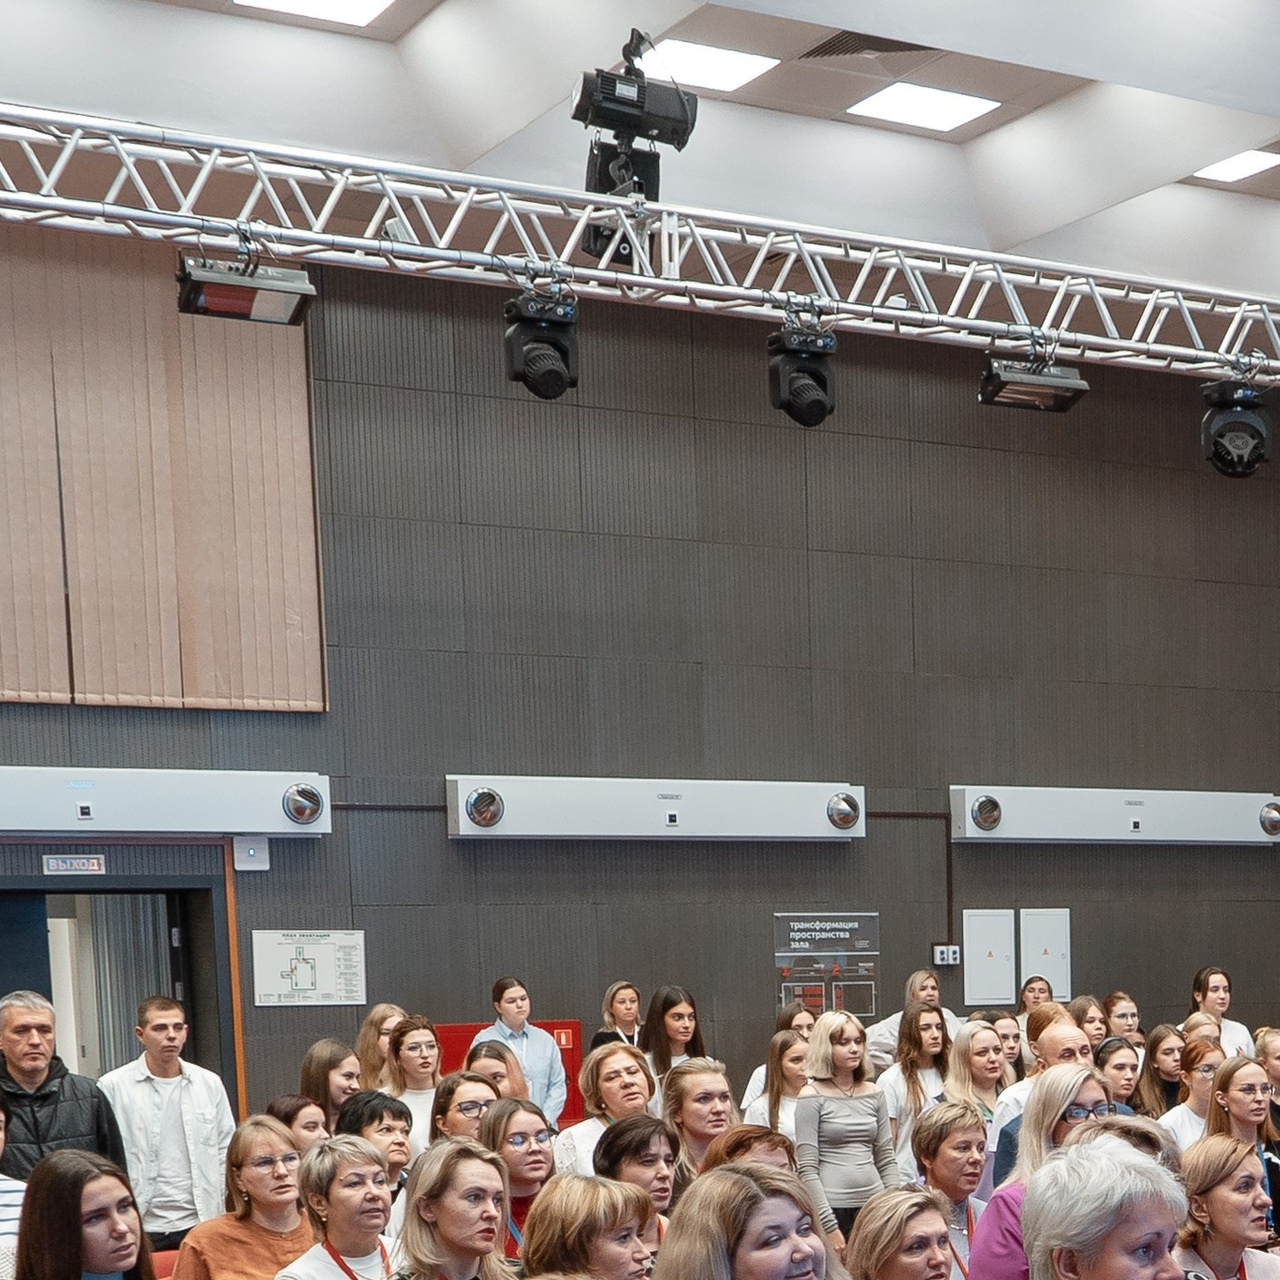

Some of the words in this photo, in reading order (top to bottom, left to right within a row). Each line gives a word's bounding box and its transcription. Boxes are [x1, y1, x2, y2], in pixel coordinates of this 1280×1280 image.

[48, 859, 99, 870] ВЫХОД
[789, 921, 859, 930] трансформация
[789, 932, 850, 940] пространства
[790, 941, 810, 949] зала
[831, 964, 840, 976] 2
